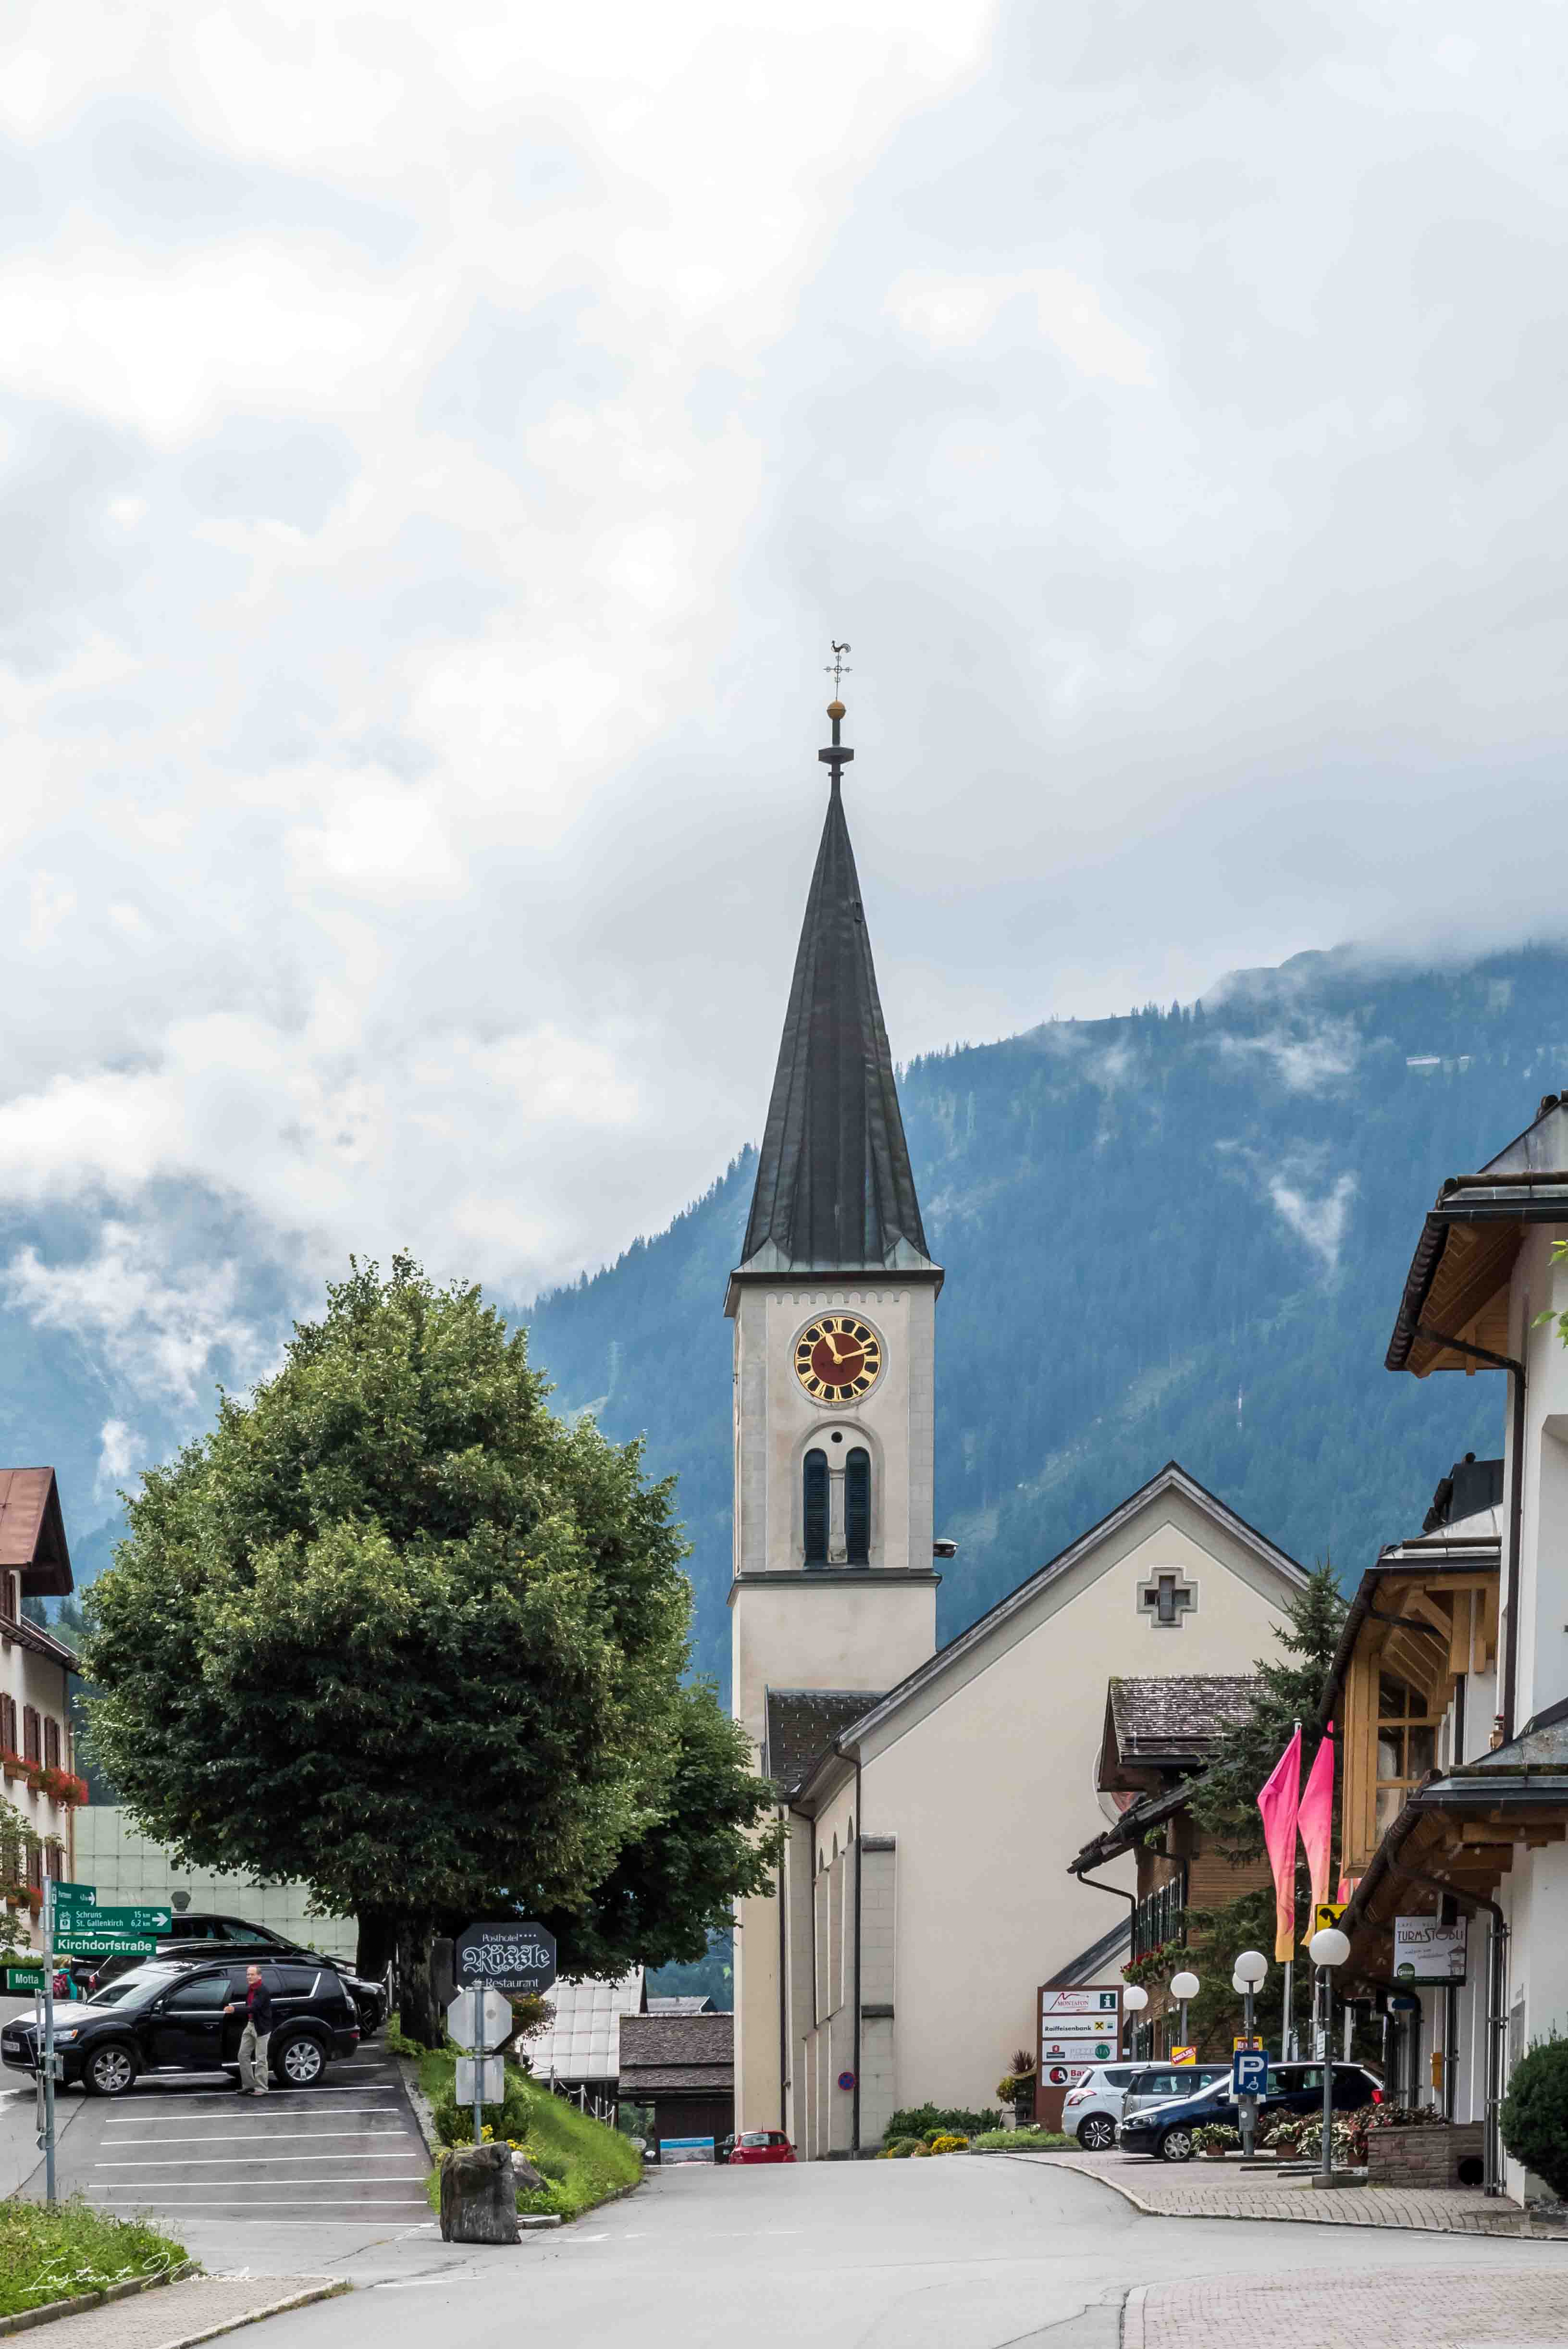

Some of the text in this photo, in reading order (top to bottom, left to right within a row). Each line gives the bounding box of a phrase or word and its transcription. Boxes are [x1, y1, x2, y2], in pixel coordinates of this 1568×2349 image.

[131, 1919, 141, 1928] 6,2
[482, 1933, 519, 1942] Posthotel
[58, 1939, 152, 1951] Kirchdorfstraße
[462, 1944, 550, 1974] Rössle
[15, 1974, 39, 1984] Motta
[486, 1978, 539, 1988] Restaurant
[1238, 2056, 1264, 2085] P
